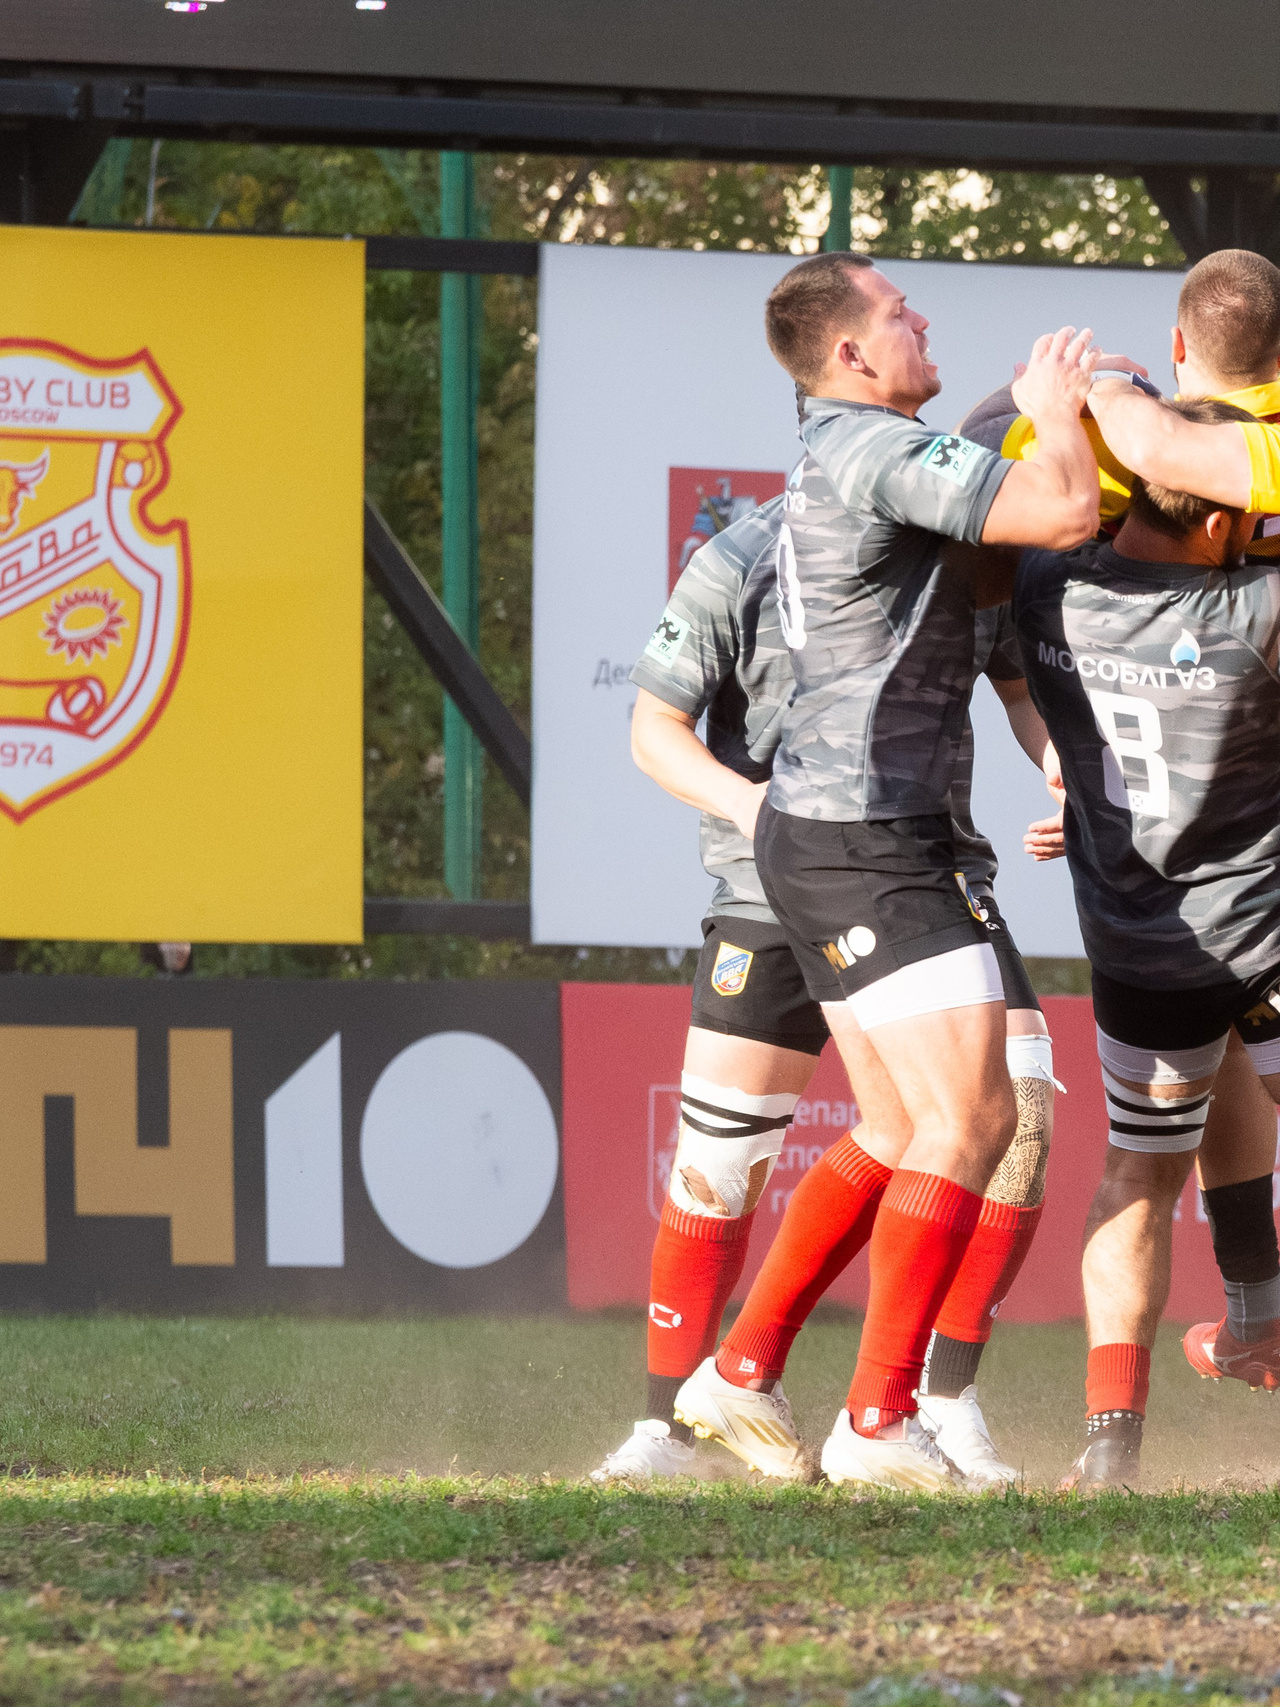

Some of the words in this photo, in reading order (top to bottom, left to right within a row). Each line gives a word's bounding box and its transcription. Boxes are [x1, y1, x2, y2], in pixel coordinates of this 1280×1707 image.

[46, 378, 131, 409] CLUB
[0, 741, 54, 768] 974
[1089, 689, 1170, 819] 8
